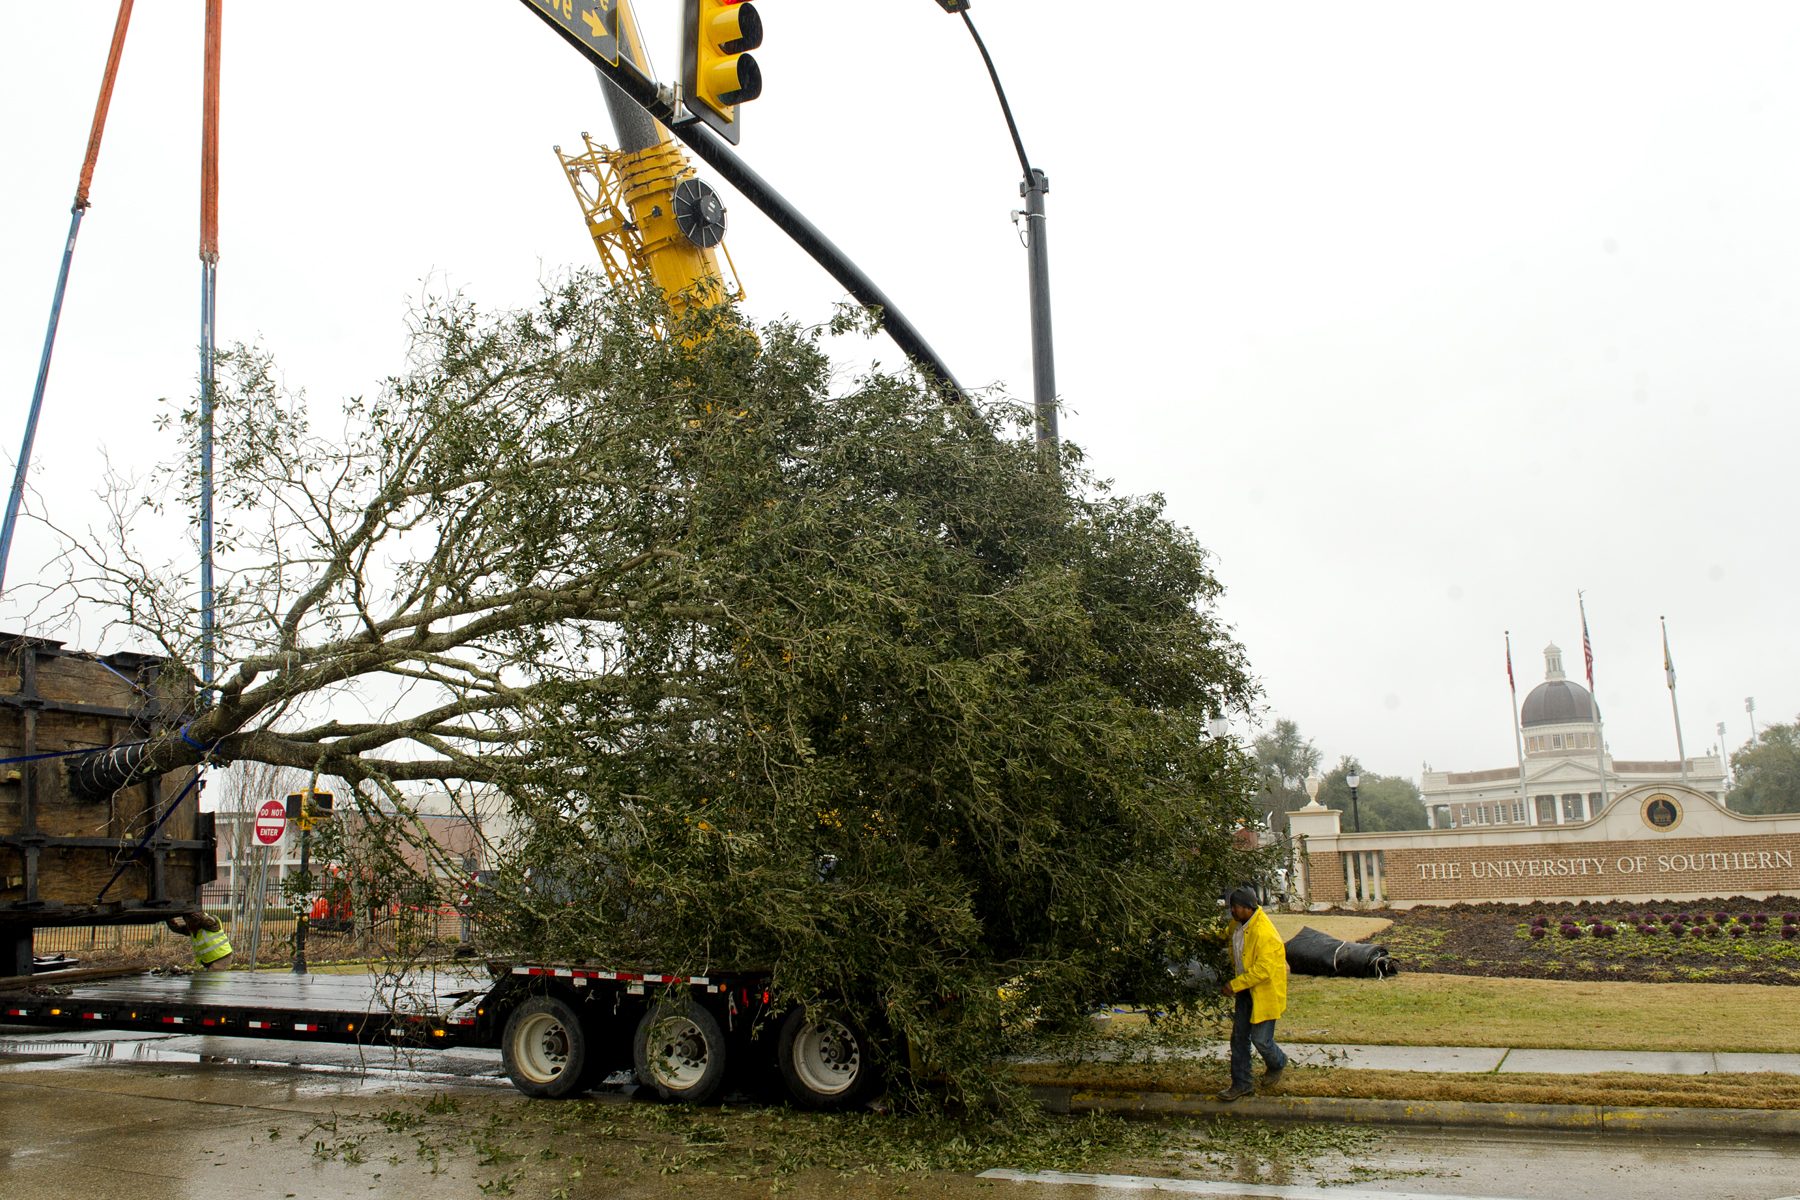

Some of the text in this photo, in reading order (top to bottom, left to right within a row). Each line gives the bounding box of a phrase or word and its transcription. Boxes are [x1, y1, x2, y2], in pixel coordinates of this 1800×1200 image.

[1416, 850, 1793, 880] THE UNIVERSITY OF SOUTHERN
